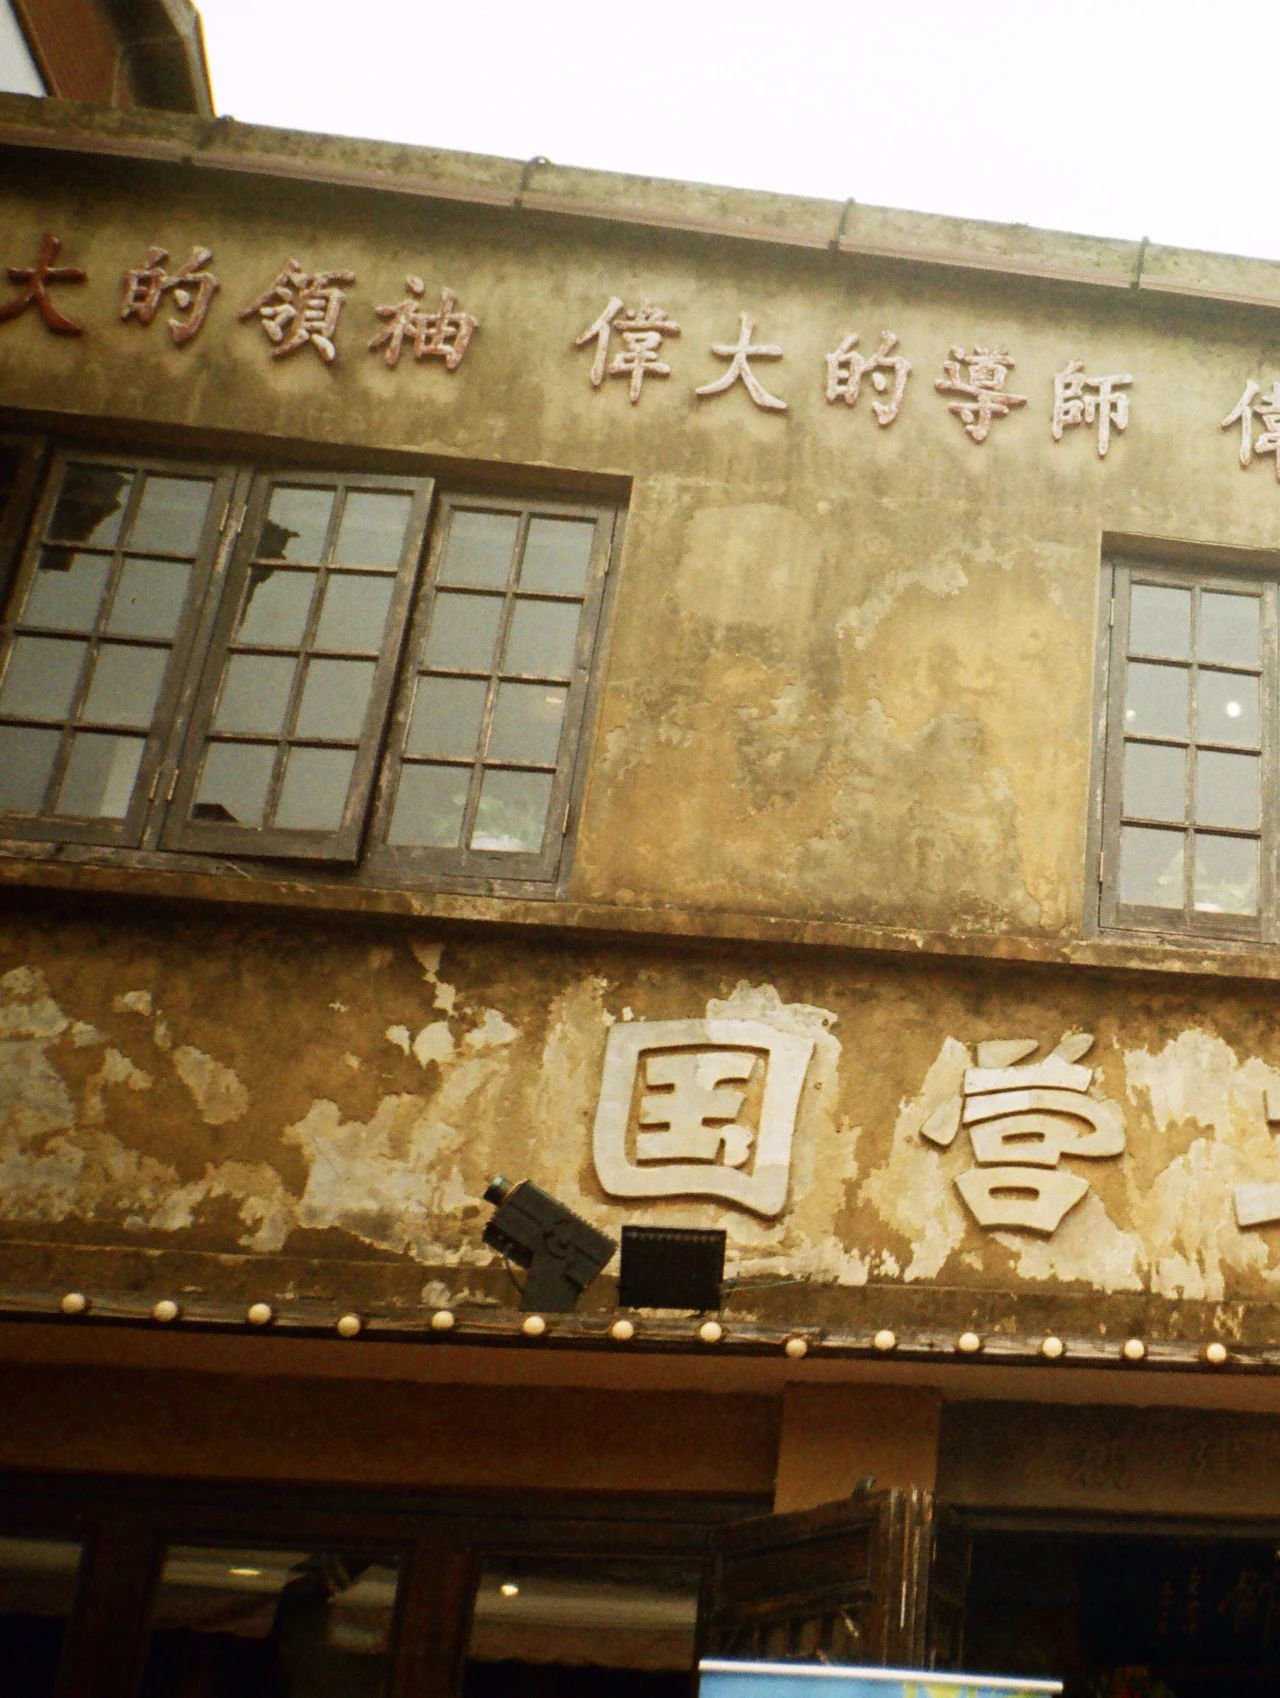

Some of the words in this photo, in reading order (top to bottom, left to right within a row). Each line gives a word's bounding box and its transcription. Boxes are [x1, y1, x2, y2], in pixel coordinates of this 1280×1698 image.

[575, 295, 1135, 460] 偉大的導師
